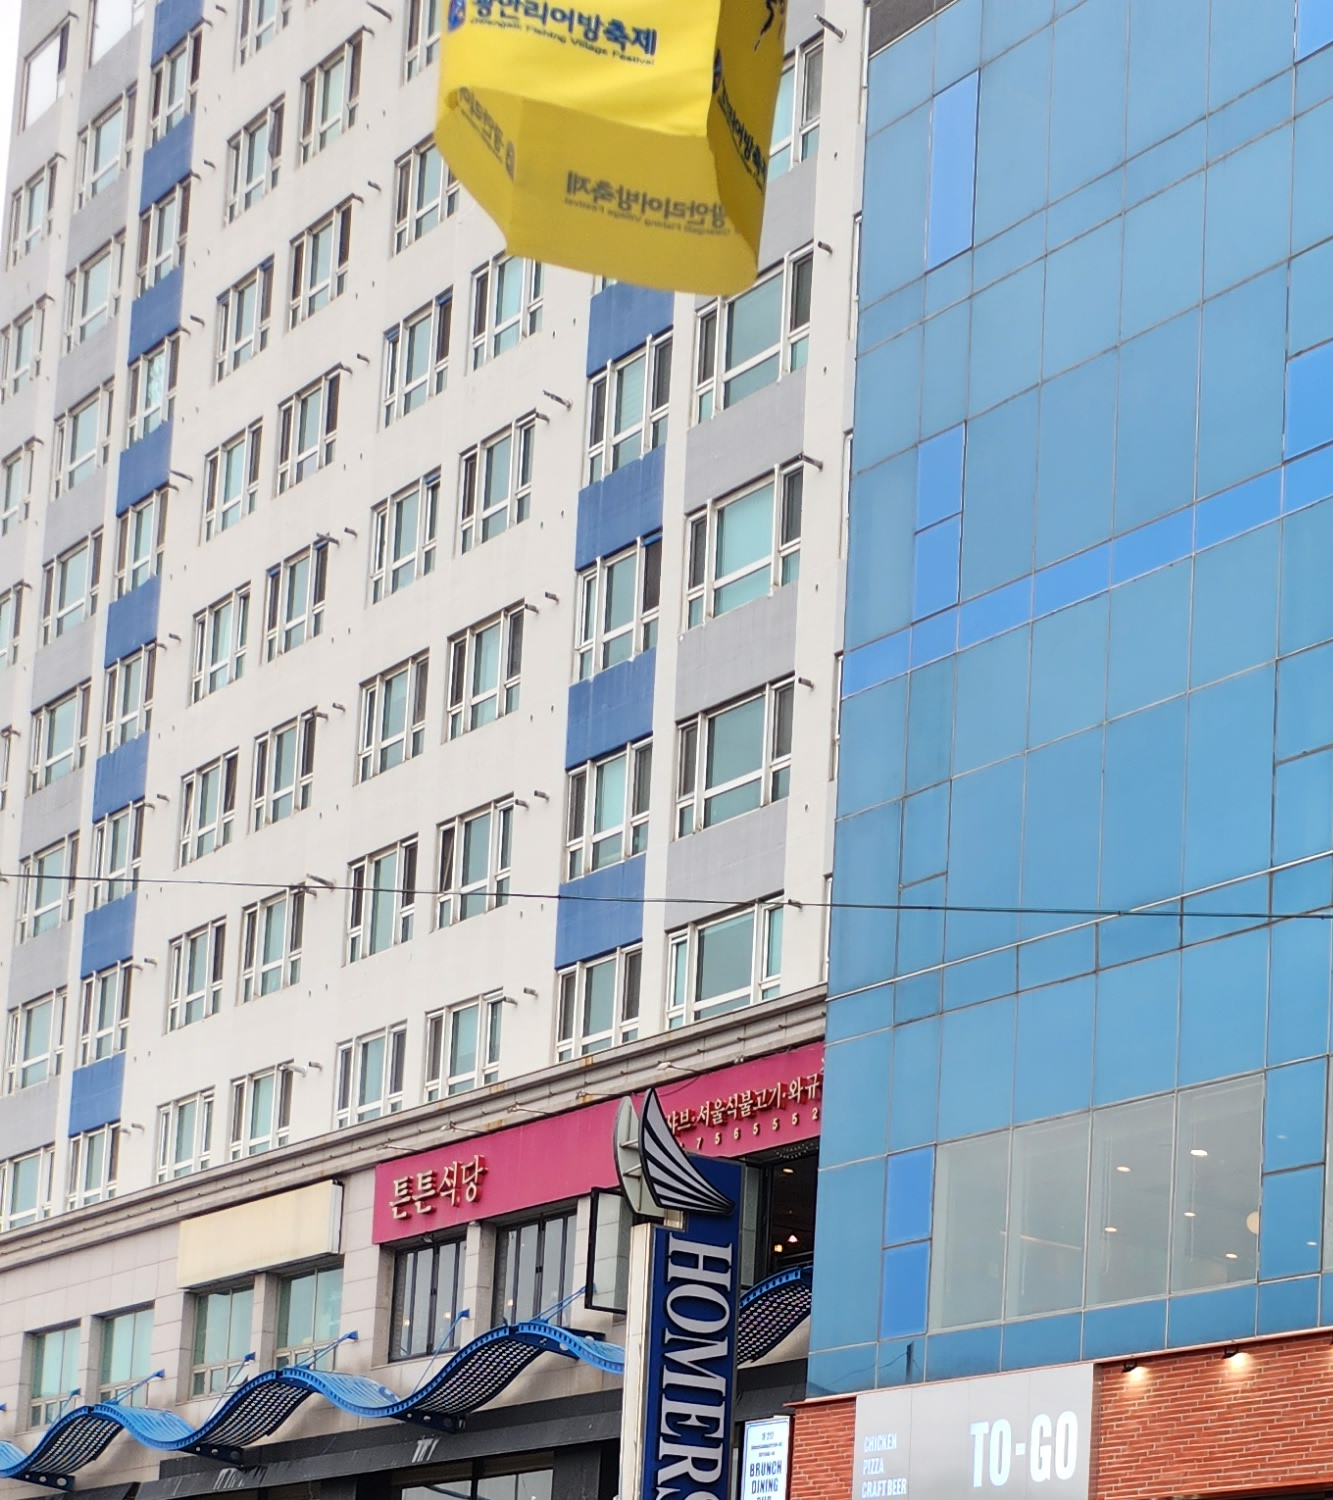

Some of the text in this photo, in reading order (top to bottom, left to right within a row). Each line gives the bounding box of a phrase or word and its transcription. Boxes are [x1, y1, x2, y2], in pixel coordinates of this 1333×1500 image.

[571, 36, 608, 56] Village
[612, 49, 655, 66] Festival
[389, 1154, 488, 1219] 튼튼식당
[864, 1432, 897, 1453] CHICKEN
[969, 1410, 1079, 1488] TO-GO
[749, 1460, 783, 1477] BRUNCH
[862, 1457, 885, 1476] PIZZA
[751, 1478, 779, 1494] DINING
[862, 1478, 907, 1499] CRAFT BEER
